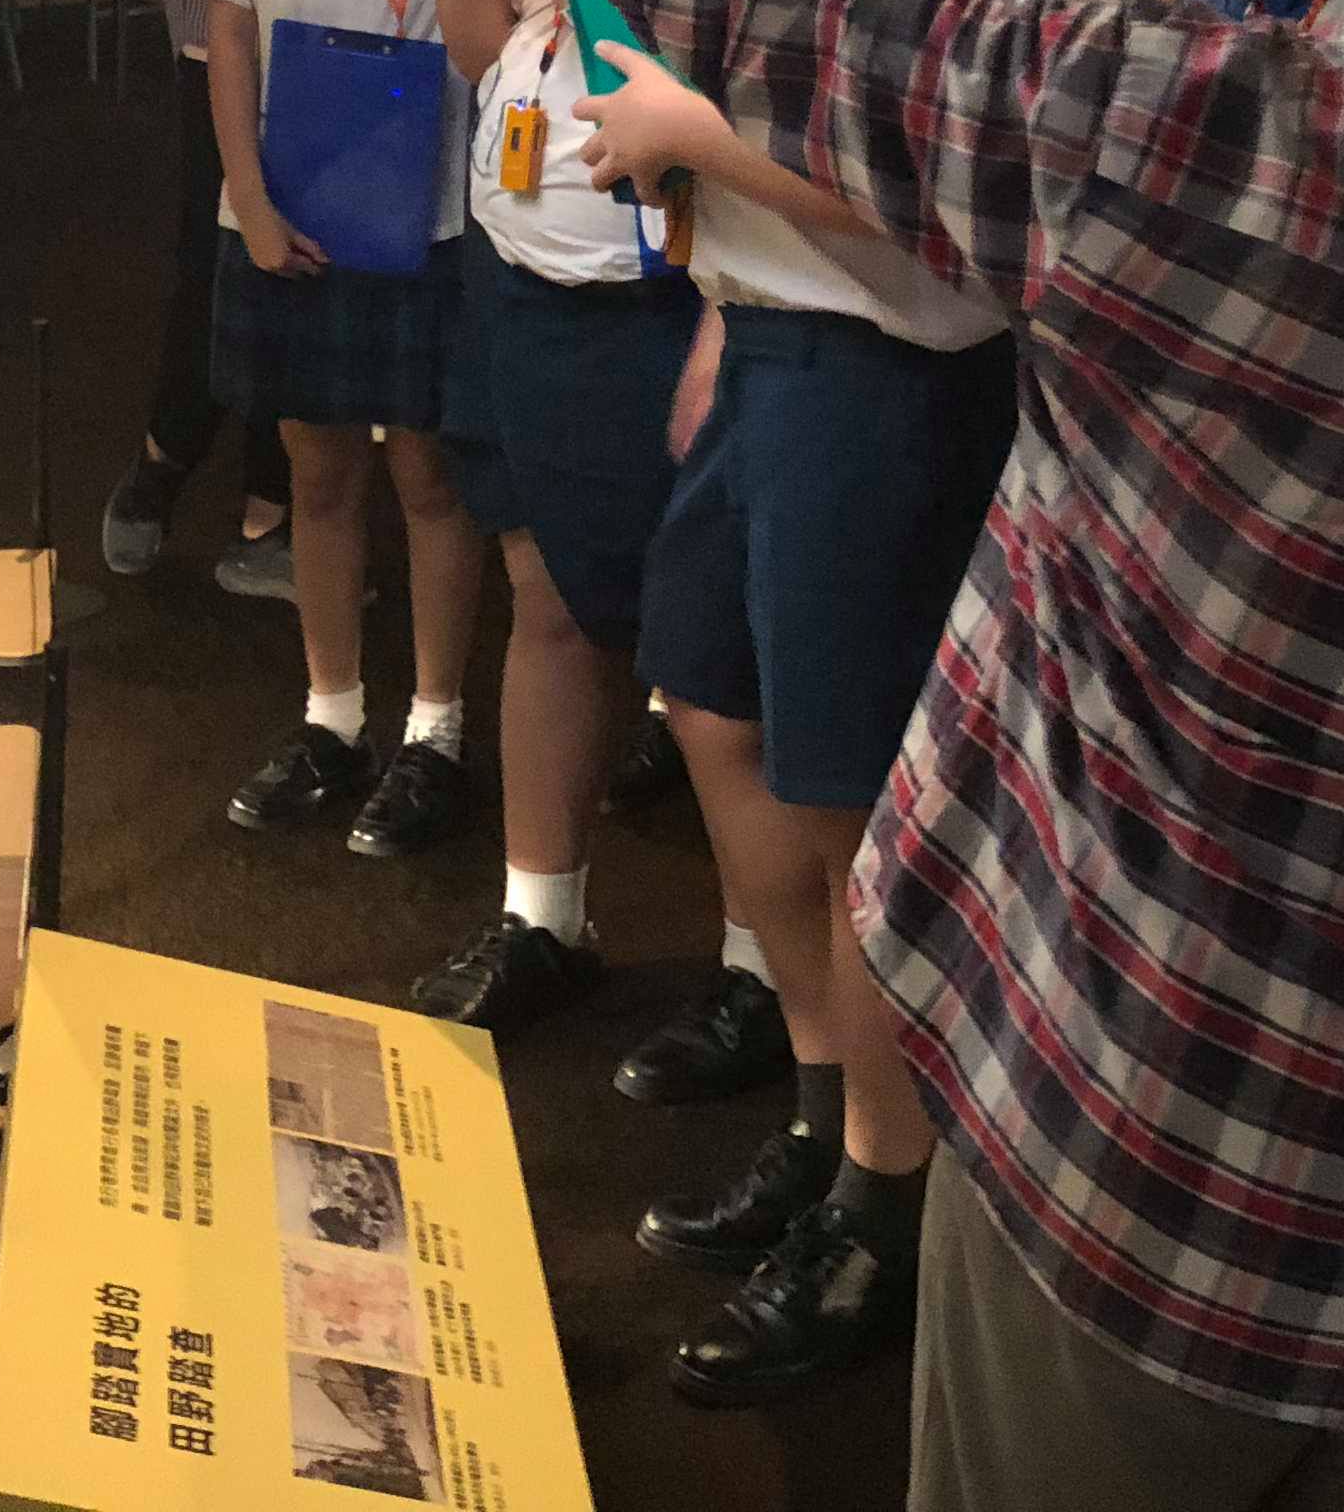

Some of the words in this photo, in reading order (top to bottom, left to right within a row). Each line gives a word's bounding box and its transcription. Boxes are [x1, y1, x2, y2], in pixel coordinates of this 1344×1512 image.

[89, 1283, 141, 1443] 腳踏實地的
[167, 1326, 215, 1457] 田野踏查
